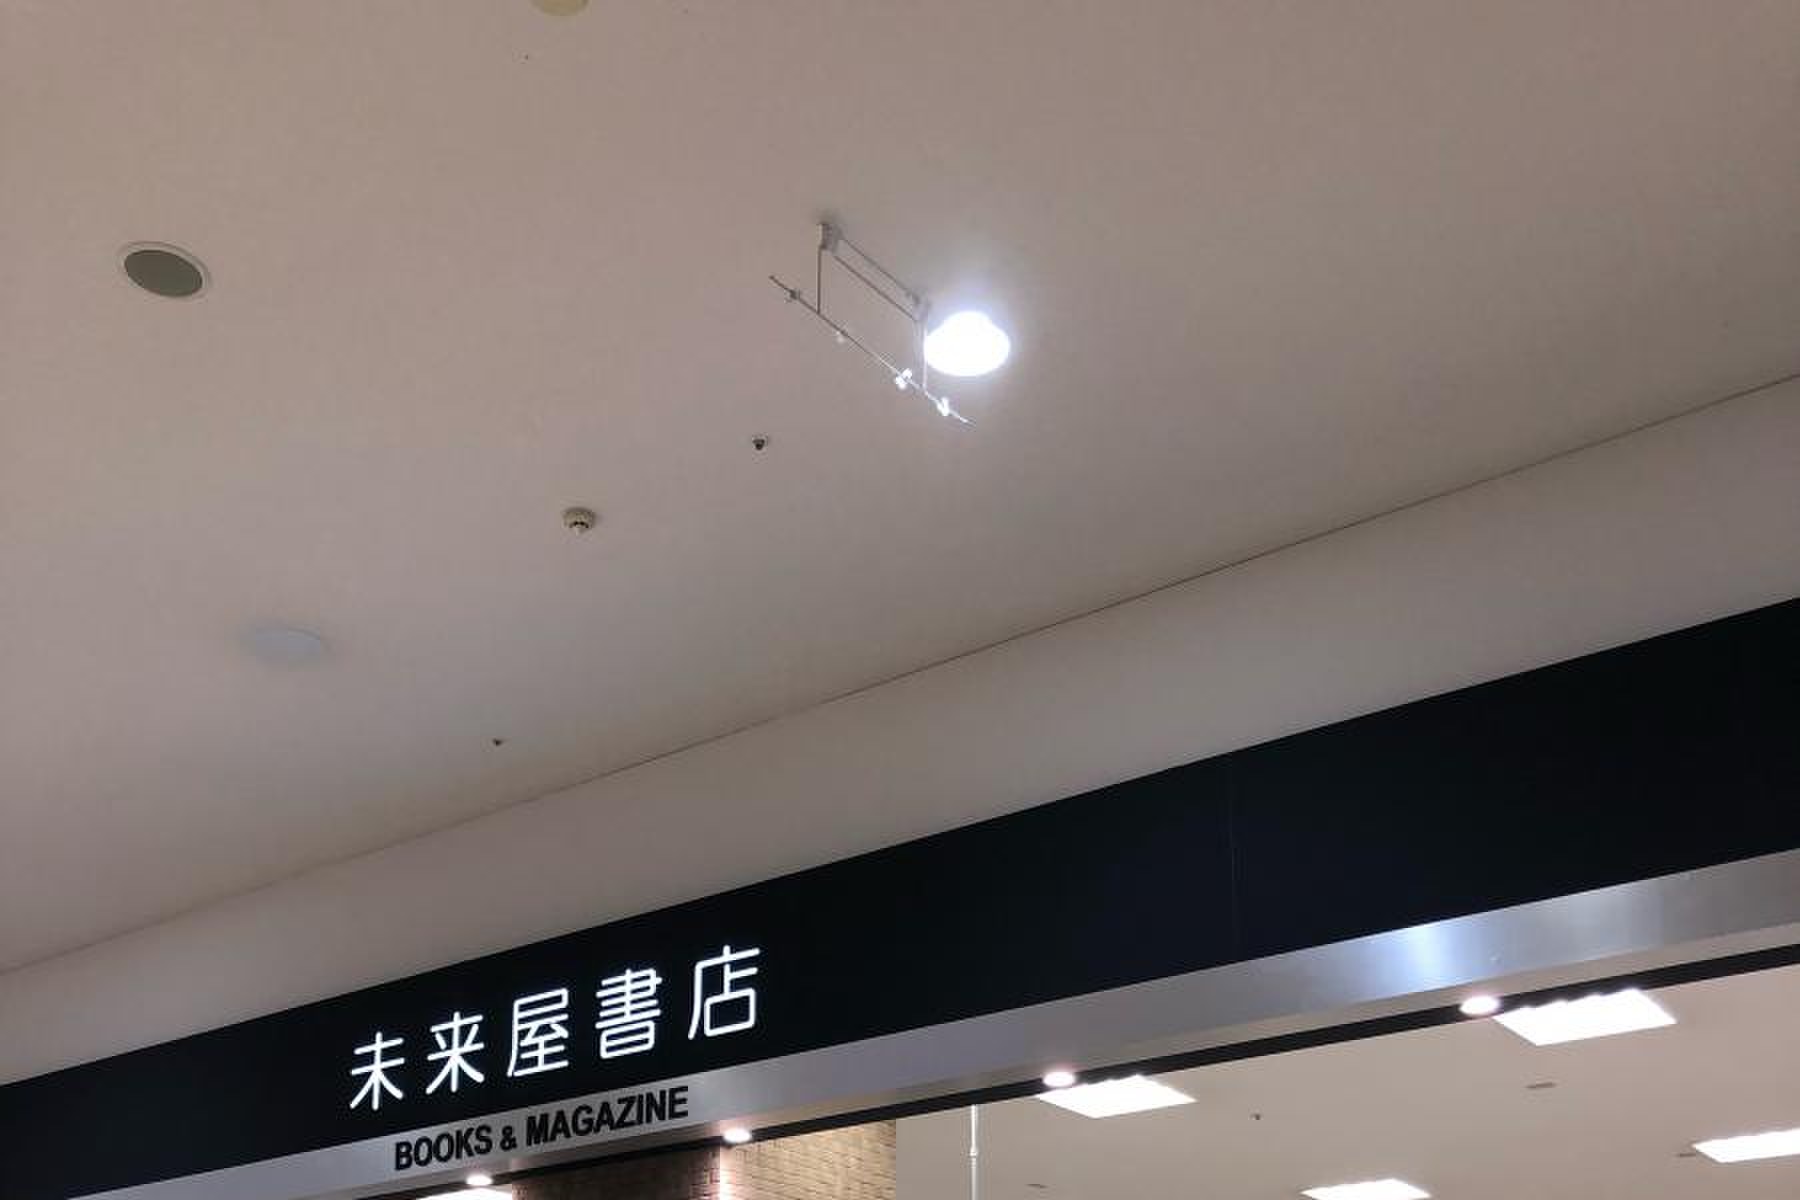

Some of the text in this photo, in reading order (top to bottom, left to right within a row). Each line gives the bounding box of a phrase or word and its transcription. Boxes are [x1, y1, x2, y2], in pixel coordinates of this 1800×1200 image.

[349, 944, 761, 1111] 未来屋書店
[395, 1086, 689, 1170] BOOKS & MAGAZINE
